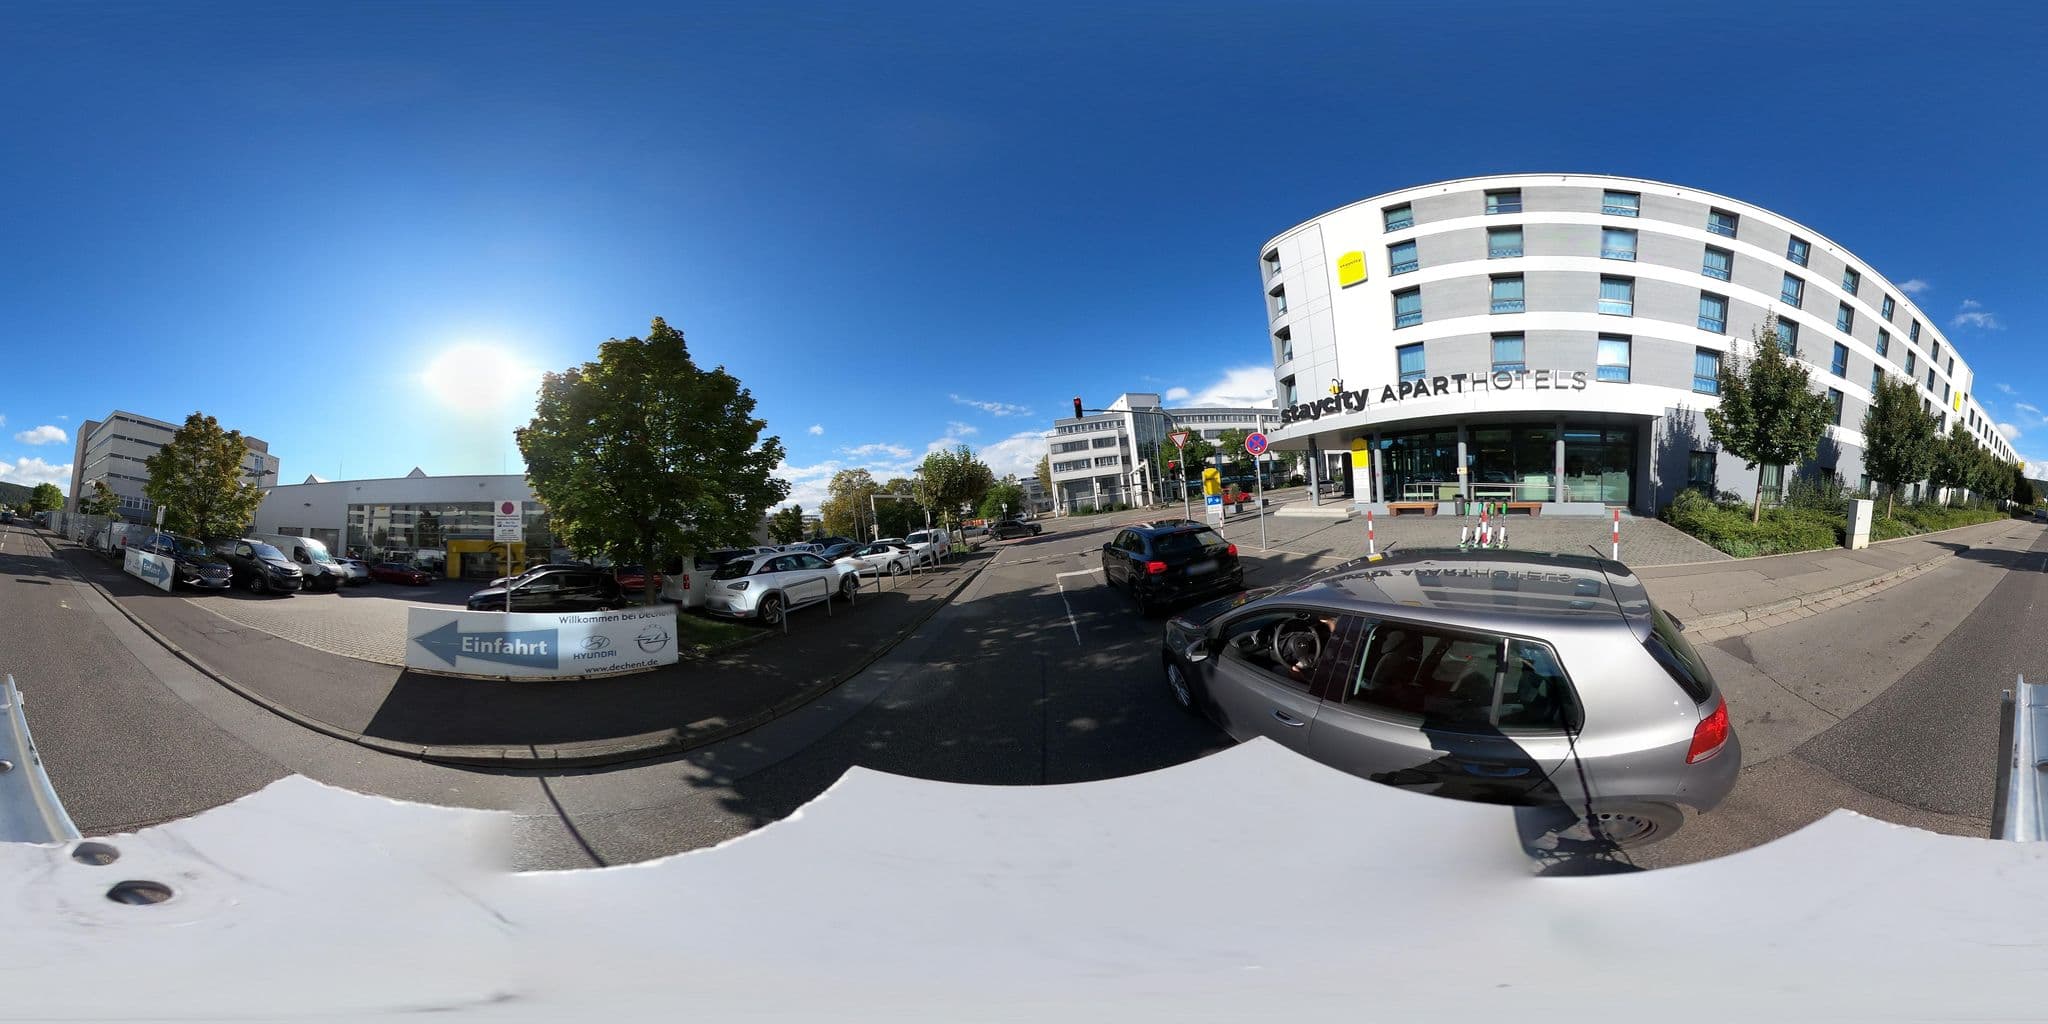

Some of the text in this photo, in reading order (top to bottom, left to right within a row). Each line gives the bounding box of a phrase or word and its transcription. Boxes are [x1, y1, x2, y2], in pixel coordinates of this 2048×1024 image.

[1281, 369, 1586, 423] staycity APARTHOTELS
[559, 613, 620, 624] Willkommen
[622, 612, 637, 621] bei
[462, 636, 548, 656] Einfahrt
[573, 650, 617, 660] HYUNDAI
[584, 659, 658, 673] www.dechent.de
